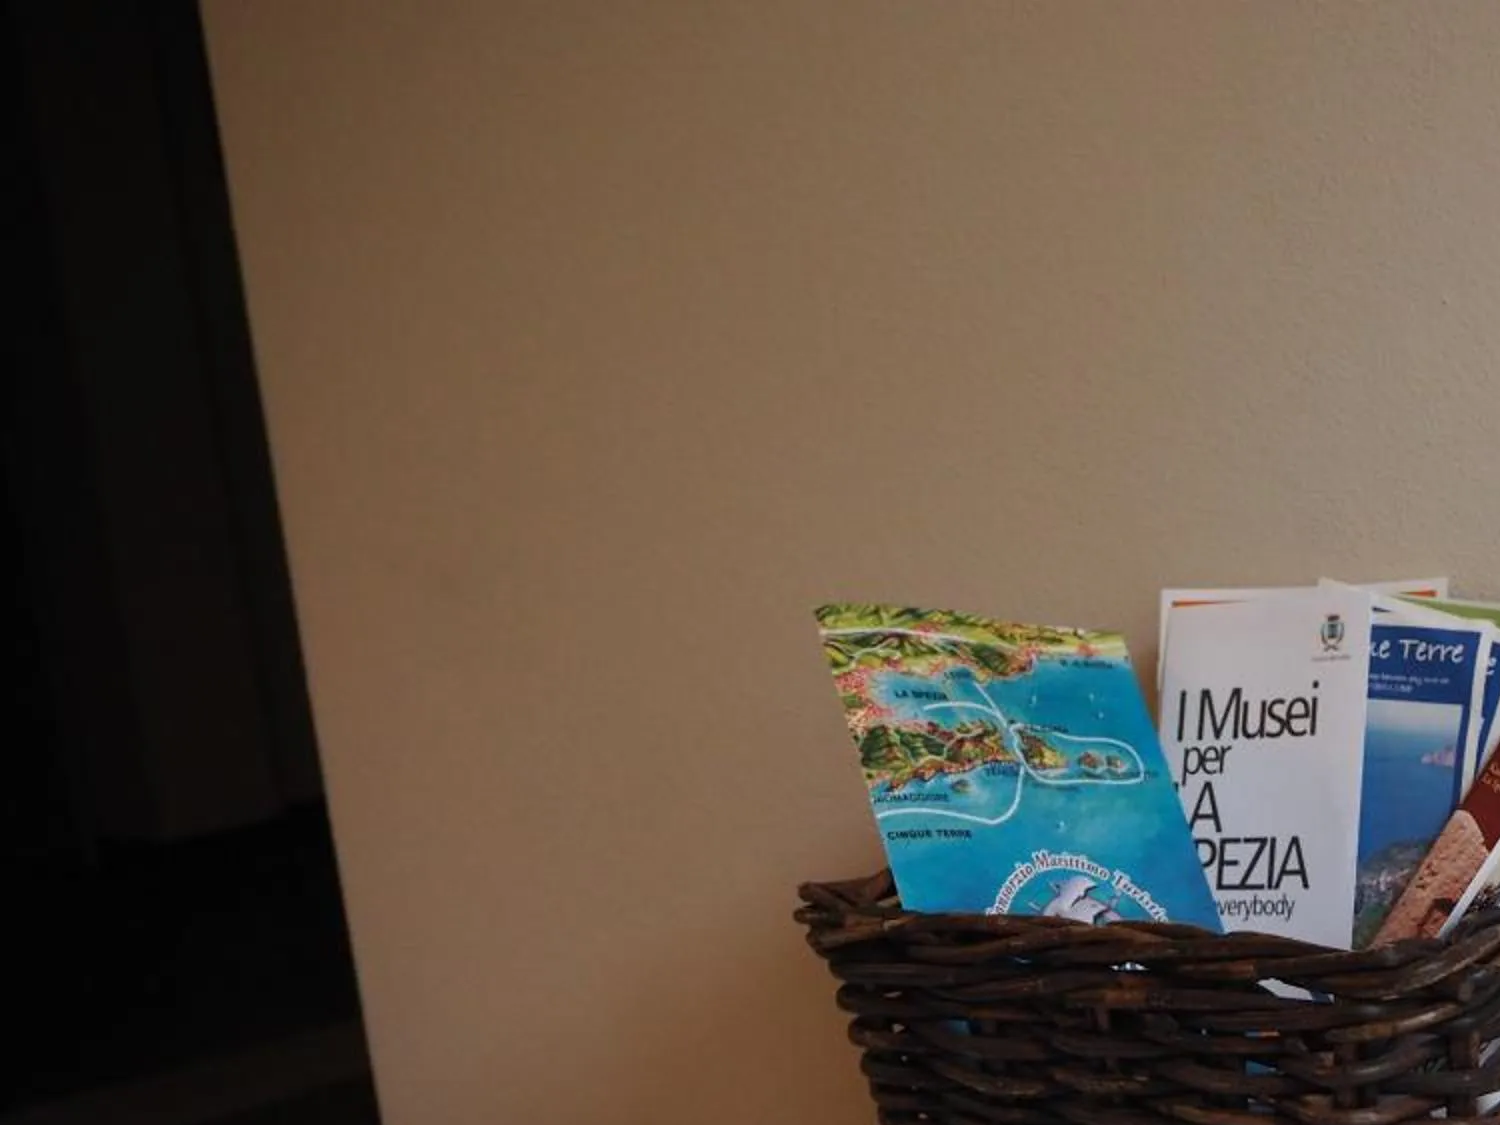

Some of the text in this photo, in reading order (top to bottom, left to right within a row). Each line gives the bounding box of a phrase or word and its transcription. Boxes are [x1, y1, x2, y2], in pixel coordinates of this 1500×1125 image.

[1399, 639, 1464, 663] Terre
[1176, 680, 1319, 742] I Musei
[1181, 744, 1232, 786] per
[1174, 781, 1222, 833] A
[887, 829, 972, 841] CINQUE TERRE
[1033, 850, 1110, 880] Marittimo
[1193, 835, 1310, 891] PEZIA
[1216, 894, 1296, 922] verybody
